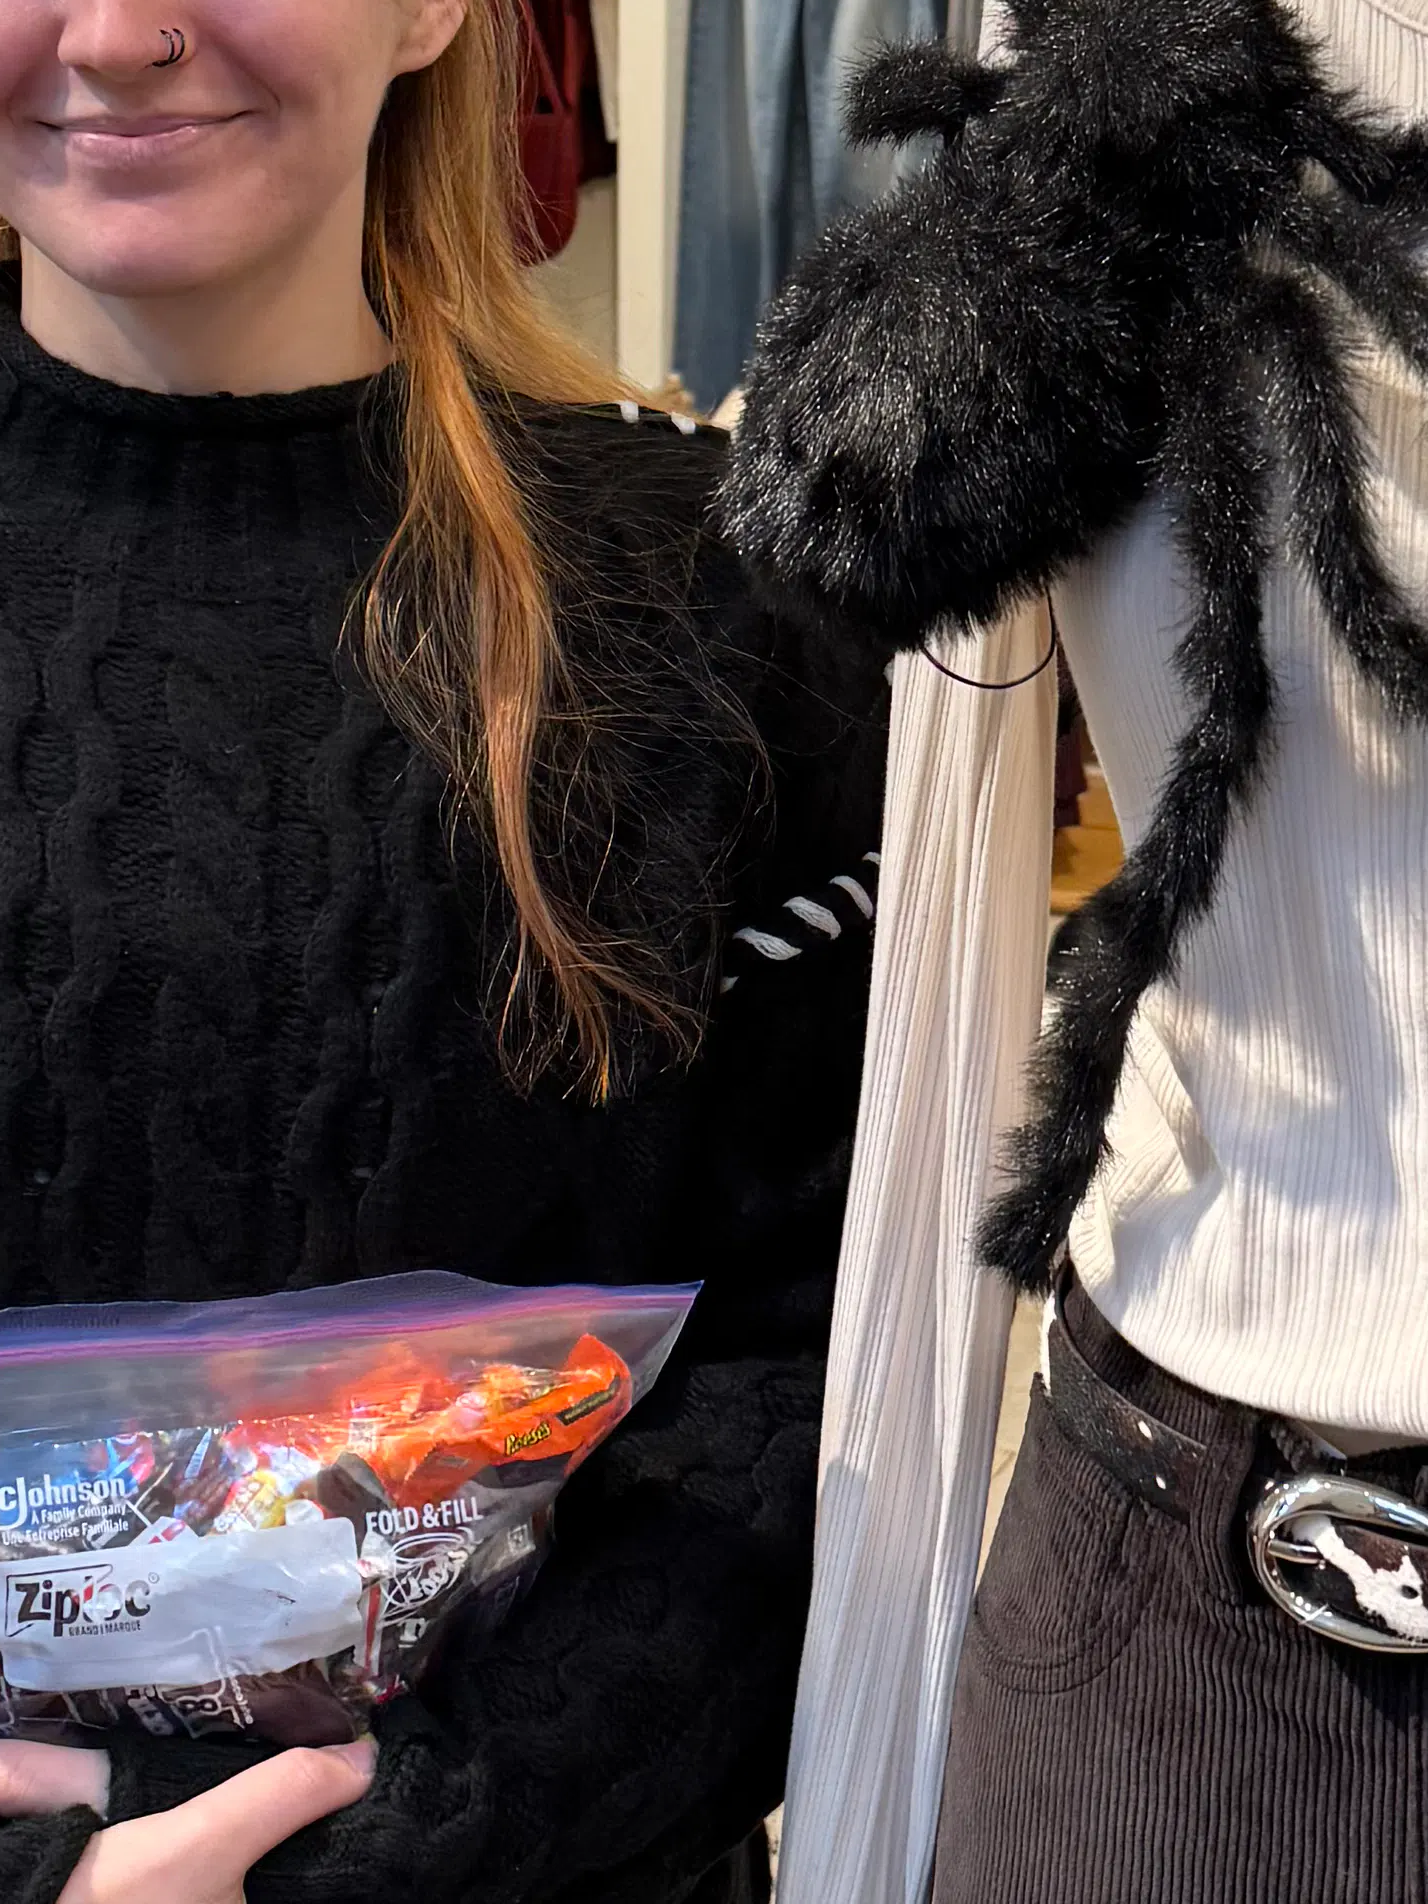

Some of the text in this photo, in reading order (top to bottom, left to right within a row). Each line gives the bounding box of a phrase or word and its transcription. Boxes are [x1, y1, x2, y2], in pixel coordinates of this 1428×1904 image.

[31, 1501, 128, 1526] A Family Company
[365, 1506, 419, 1535] FOLD
[440, 1496, 484, 1526] FILL
